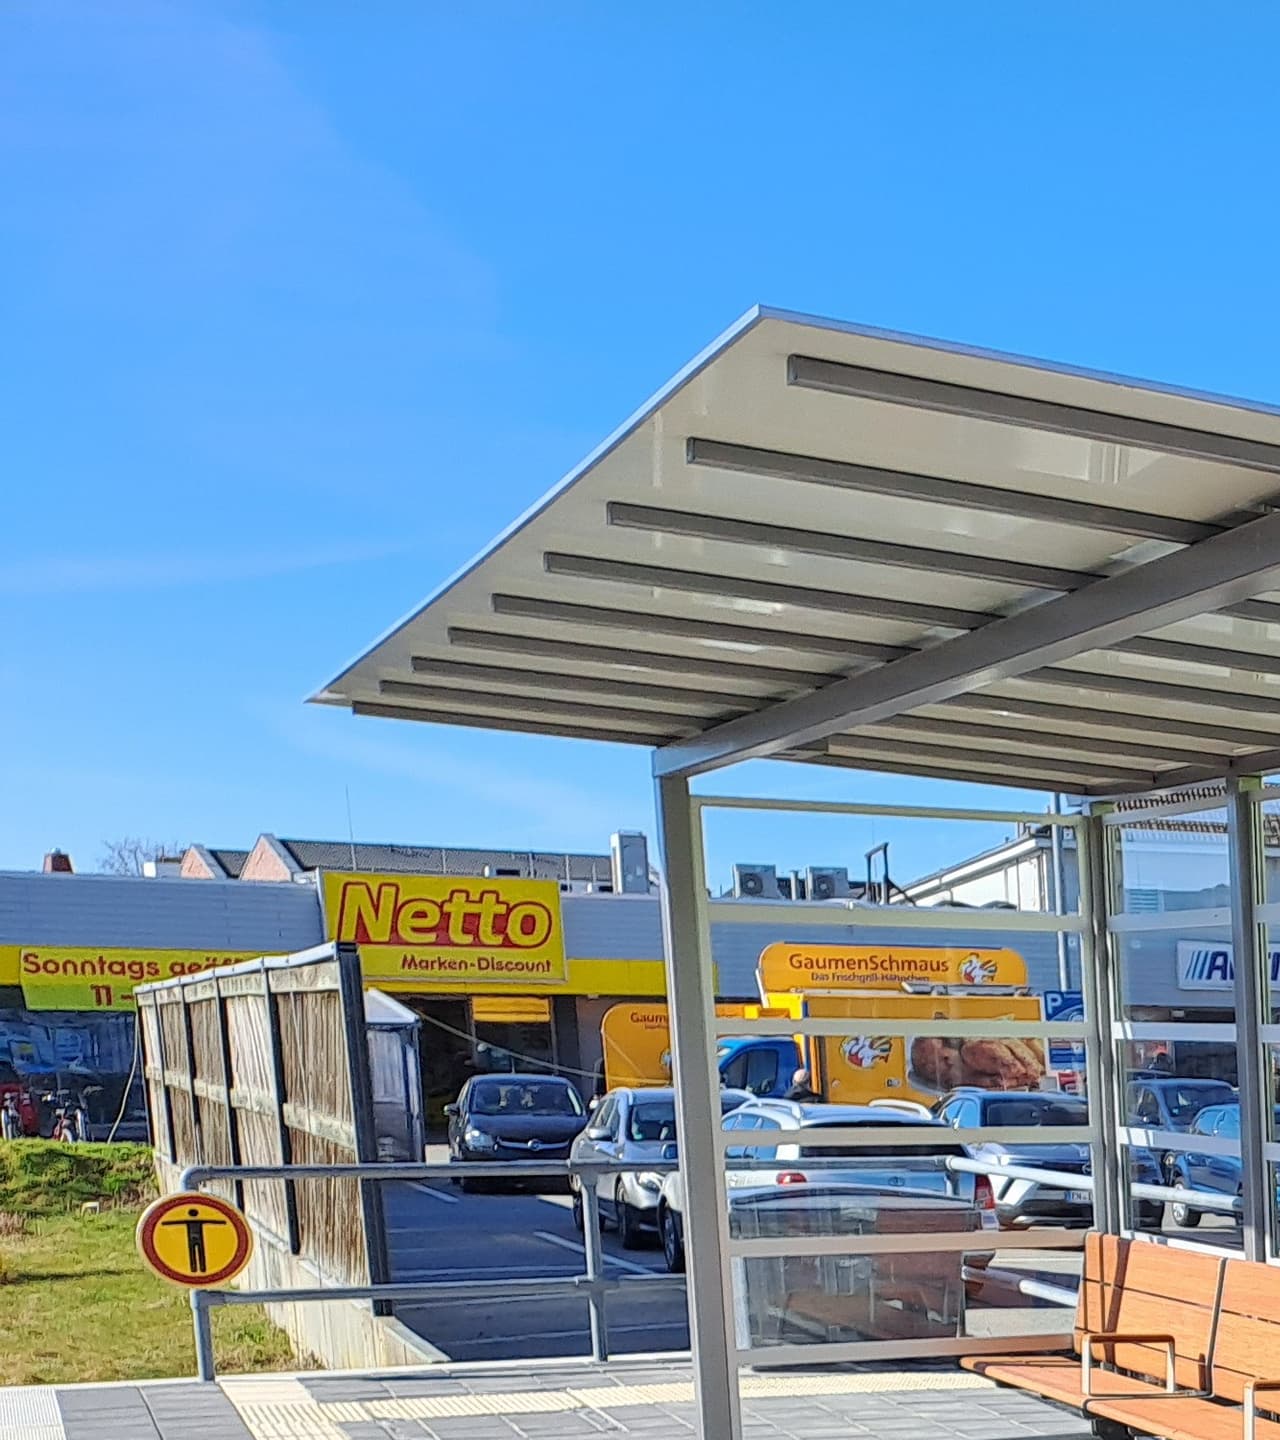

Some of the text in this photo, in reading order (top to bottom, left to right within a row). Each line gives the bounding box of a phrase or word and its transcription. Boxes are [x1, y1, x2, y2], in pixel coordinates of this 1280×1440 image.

[337, 881, 552, 949] Netto
[22, 953, 161, 980] Sonntags
[401, 955, 551, 973] Marken-Discount
[788, 953, 949, 973] GaumenSchmaus
[1046, 993, 1063, 1015] P
